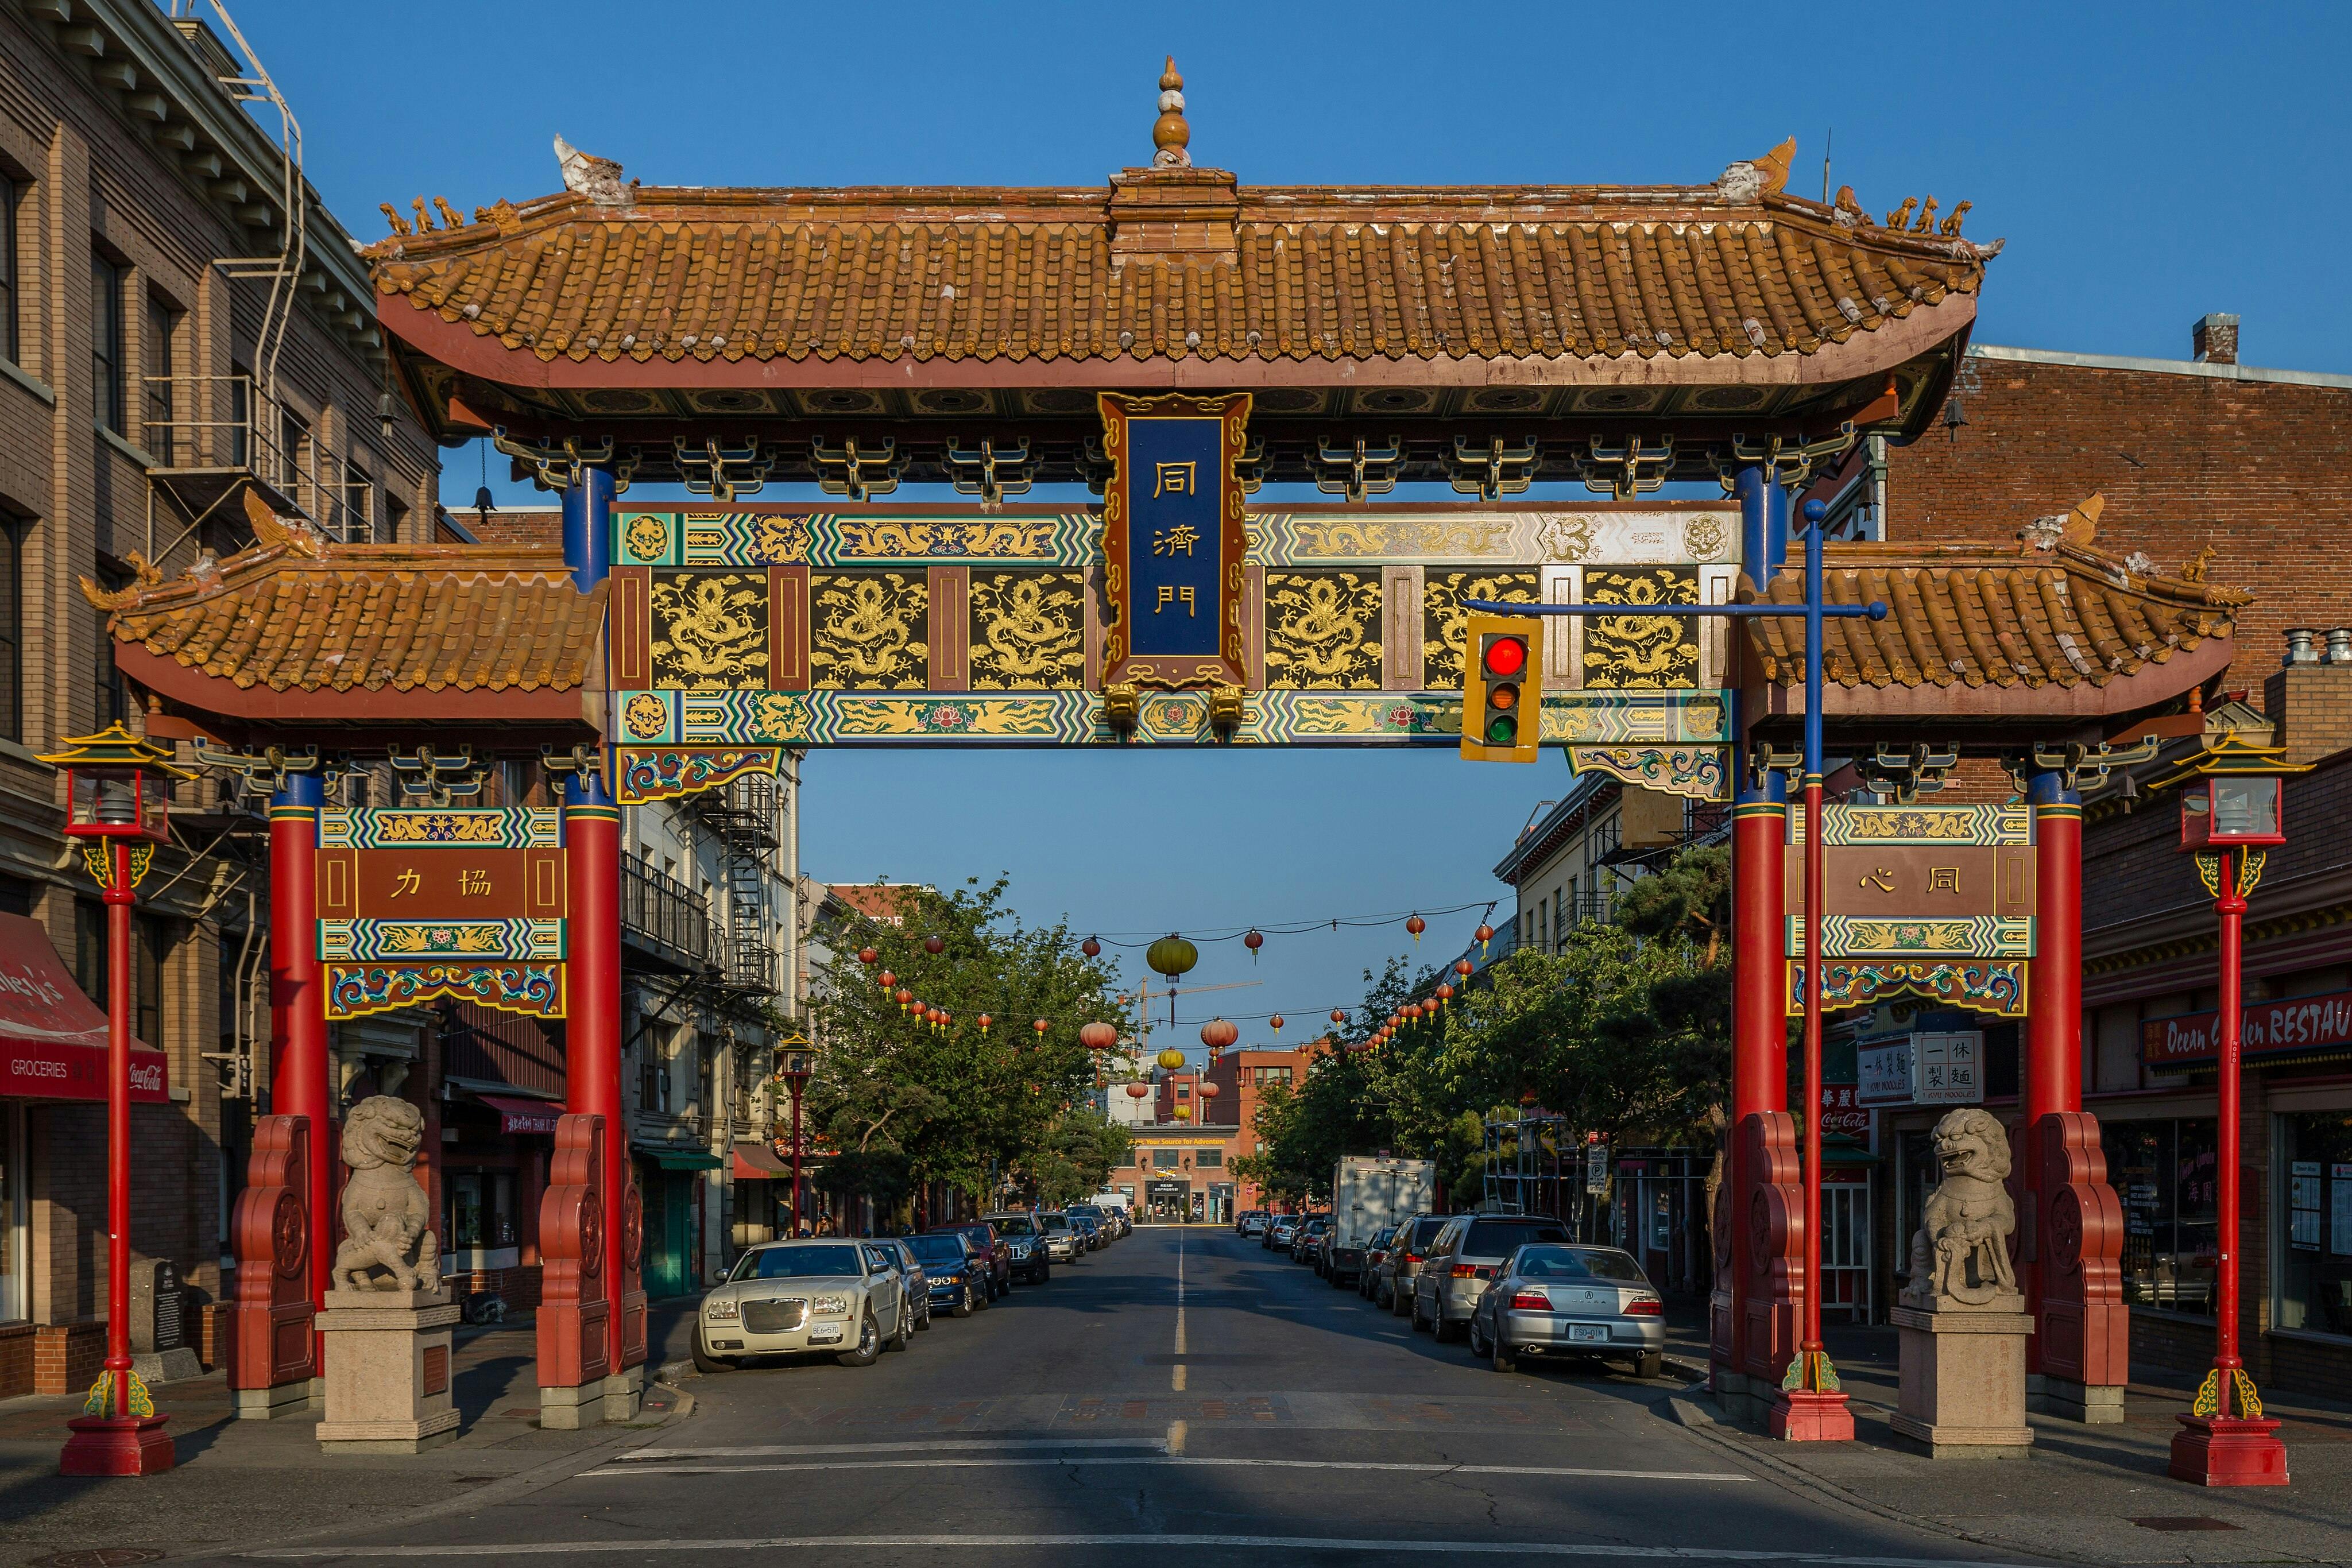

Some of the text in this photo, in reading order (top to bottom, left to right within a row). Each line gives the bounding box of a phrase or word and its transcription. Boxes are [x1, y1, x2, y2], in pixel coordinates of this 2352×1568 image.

[1152, 460, 1201, 618] 同濟門
[2167, 1021, 2206, 1054] Ocean
[11, 1059, 67, 1078] GROCERIES
[1882, 1079, 1905, 1091] NOODLES
[1821, 1089, 1859, 1108] 華麗
